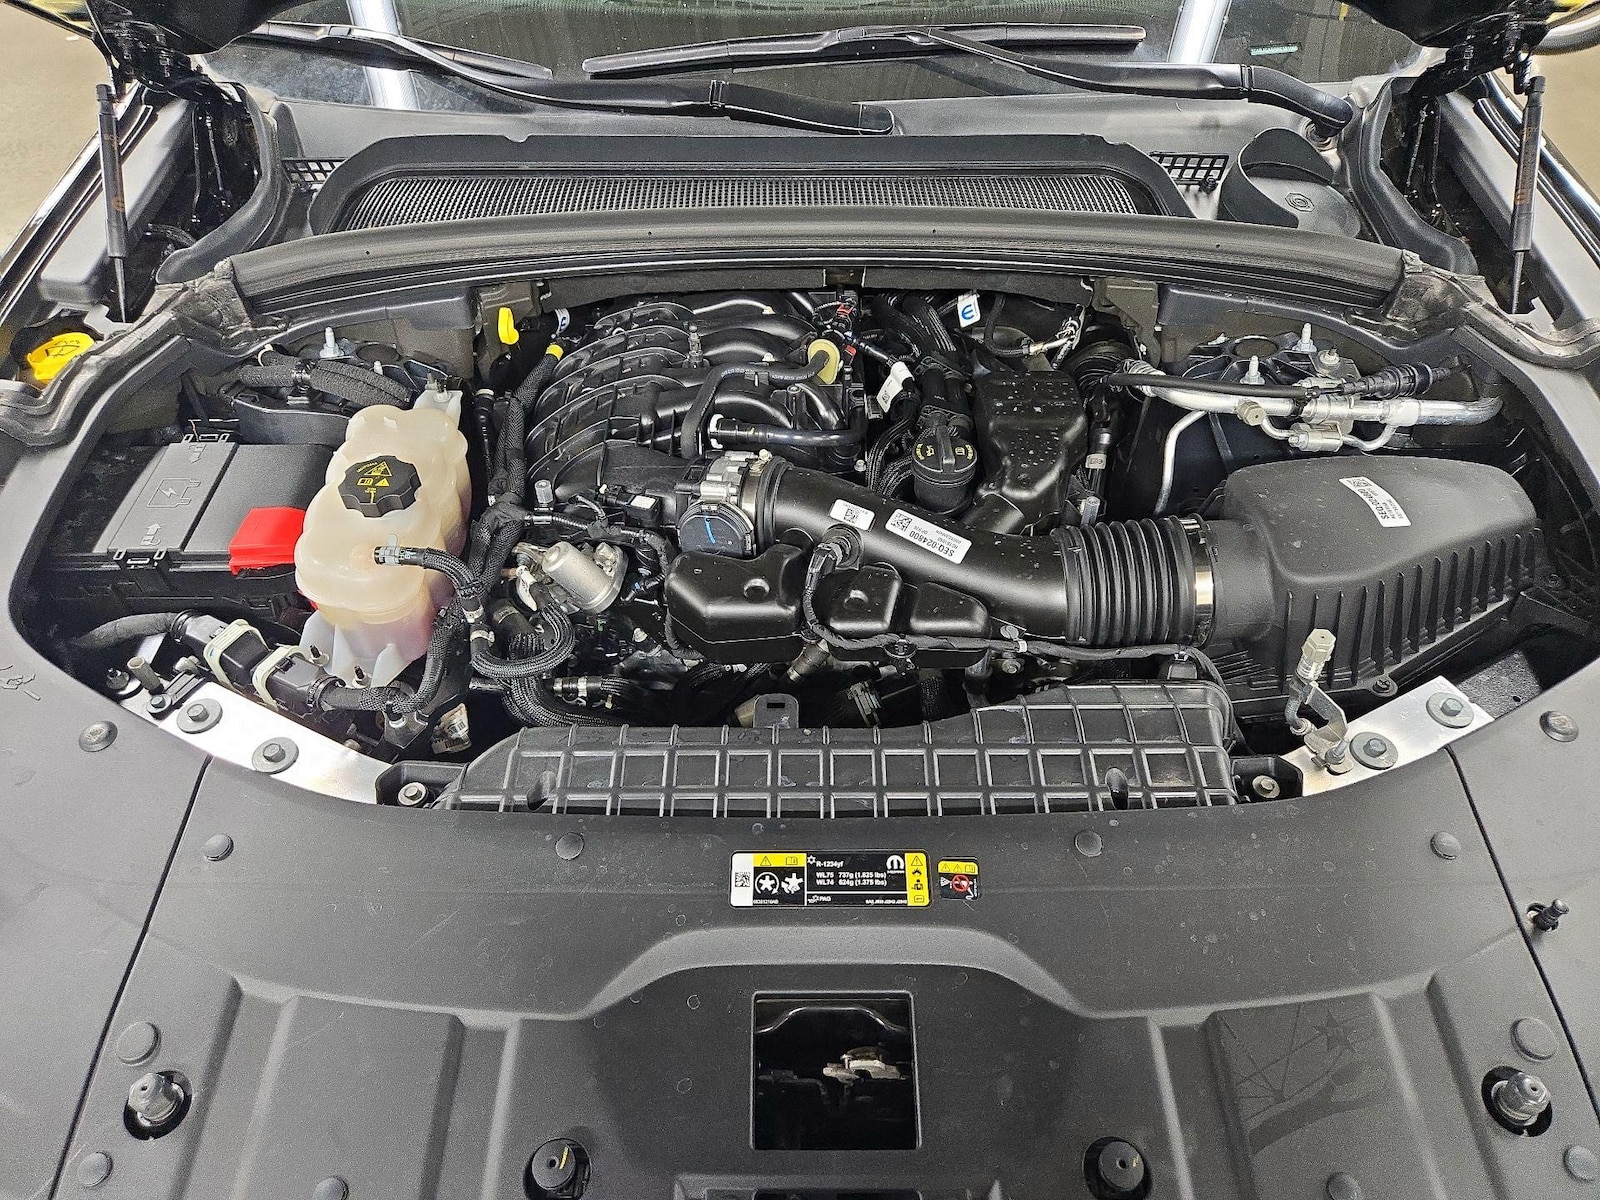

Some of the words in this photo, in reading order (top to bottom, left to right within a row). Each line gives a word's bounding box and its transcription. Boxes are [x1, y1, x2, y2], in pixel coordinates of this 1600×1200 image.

[908, 530, 955, 557] SEQ:024800
[816, 860, 844, 868] R-1234yf
[838, 871, 854, 879] 737g
[874, 871, 887, 879] lbs)
